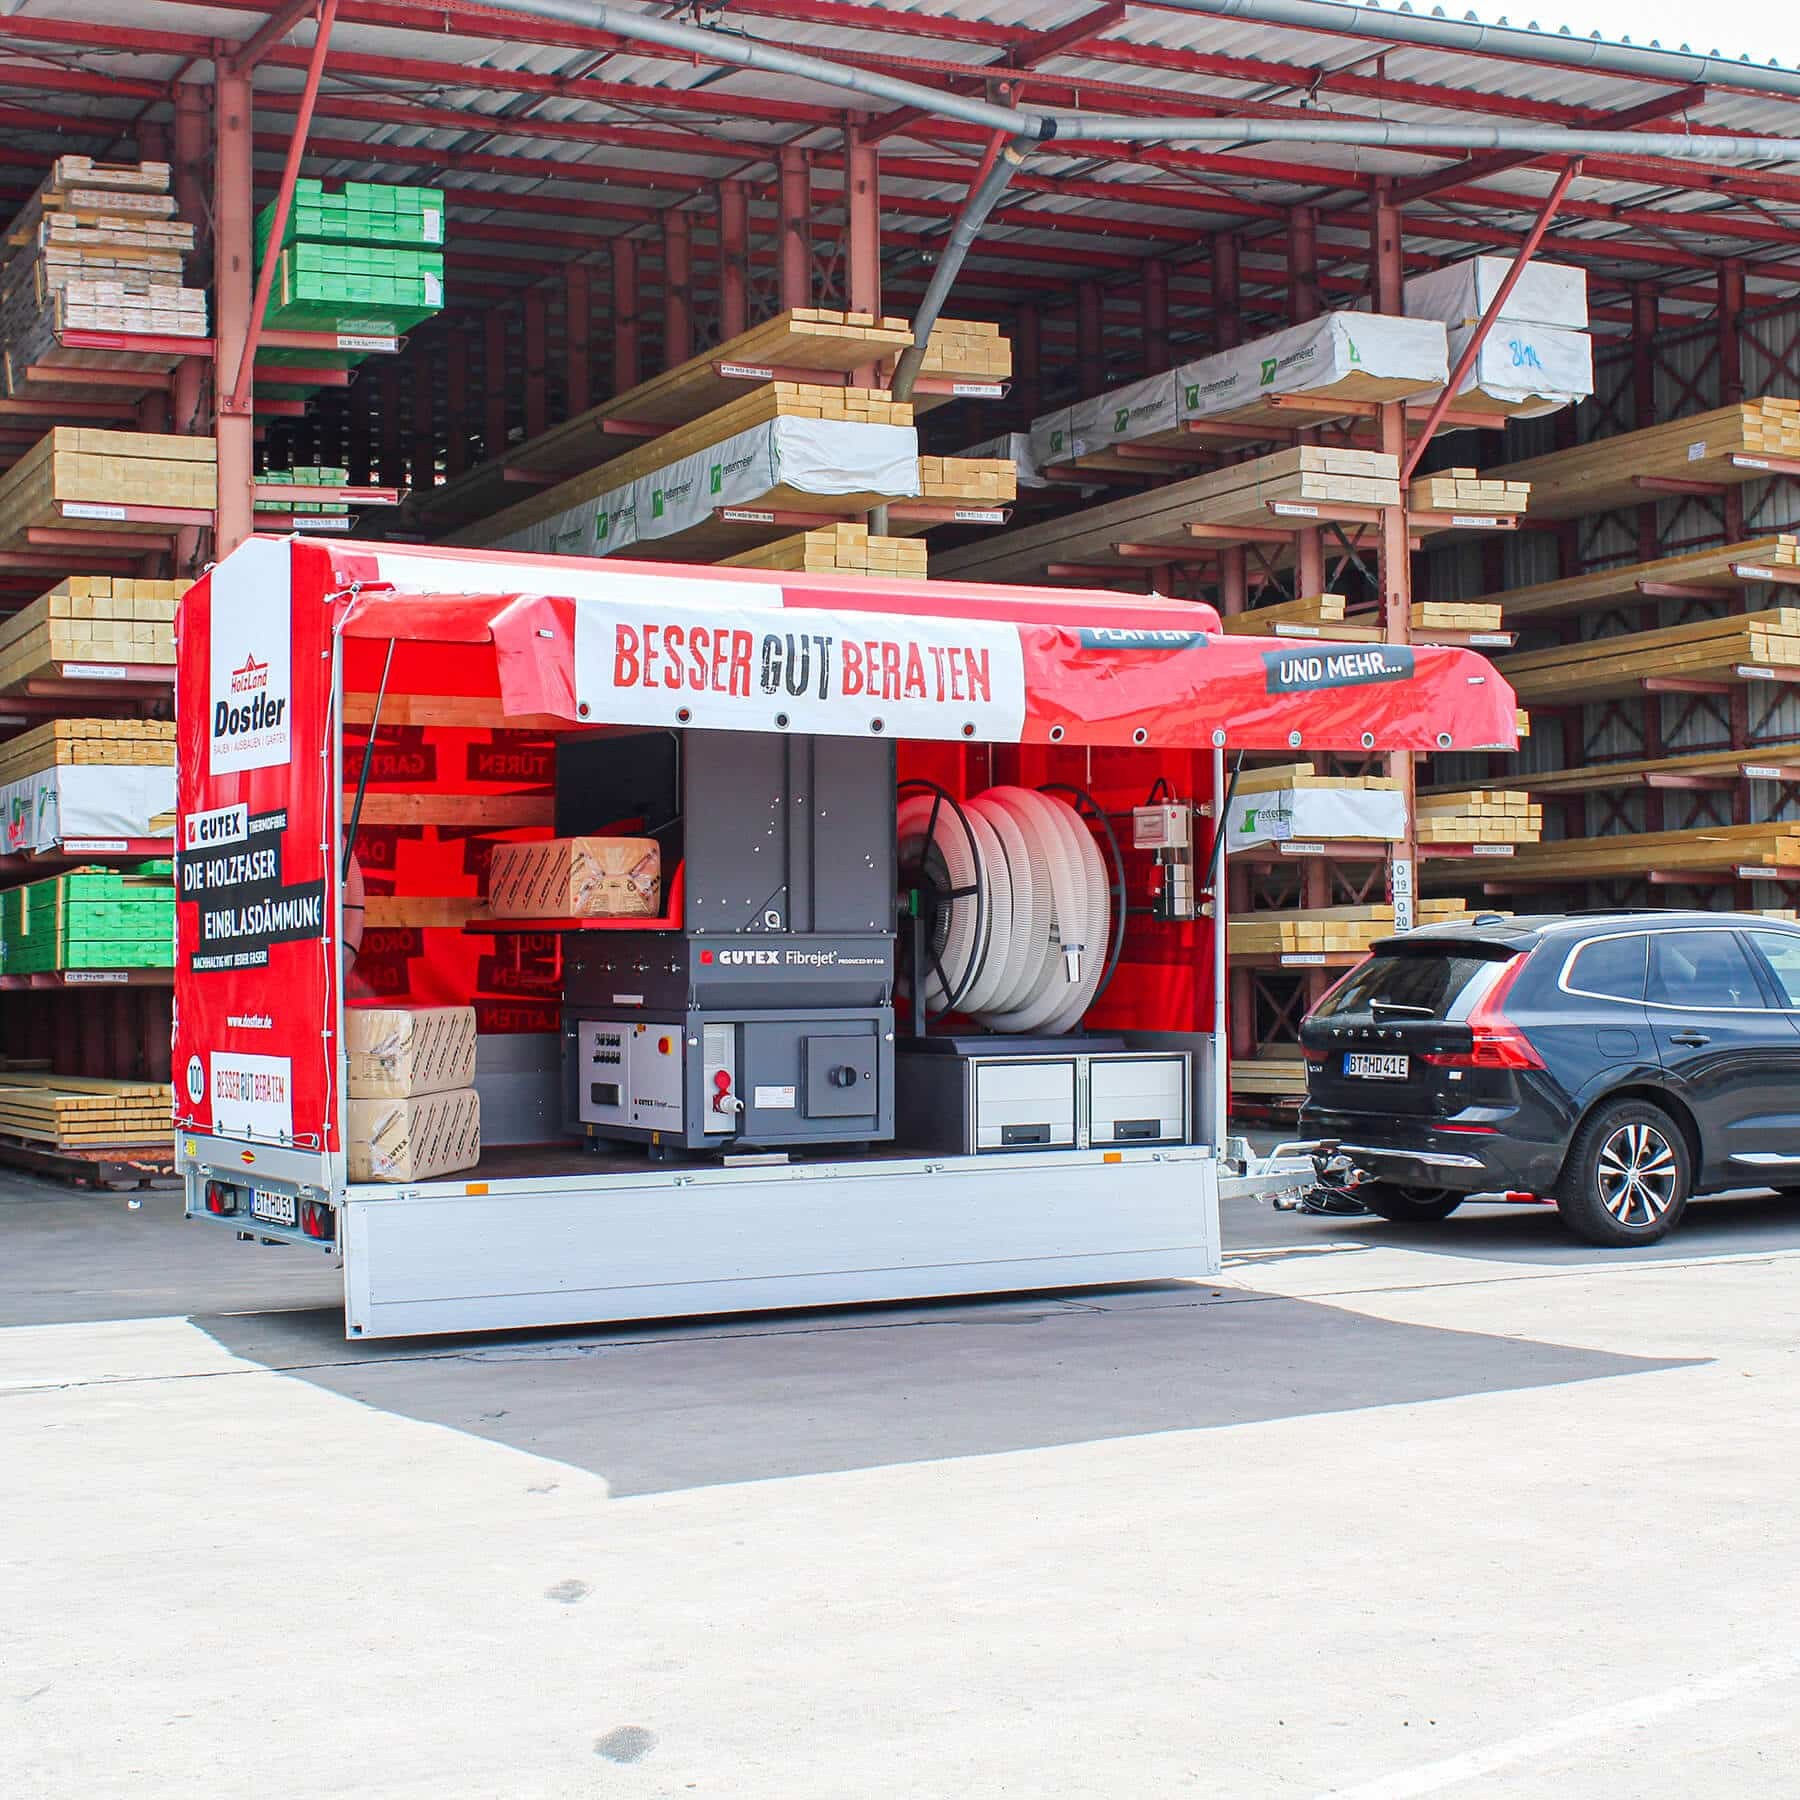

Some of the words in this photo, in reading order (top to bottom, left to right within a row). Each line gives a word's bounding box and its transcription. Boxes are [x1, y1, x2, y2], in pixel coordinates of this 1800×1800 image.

[613, 623, 753, 697] BESSER
[760, 633, 832, 700] GUT
[841, 639, 991, 702] BERATEN
[1280, 657, 1322, 684] UND
[1326, 651, 1403, 679] MEHR...
[214, 691, 286, 738] Dostler
[200, 812, 240, 841] GUTEX
[184, 862, 204, 891] DIE
[206, 849, 276, 888] HOLZFASER
[1396, 916, 1408, 927] 20
[719, 950, 780, 965] GUTEX
[1332, 1029, 1402, 1038] VOLVO
[1350, 1054, 1363, 1073] BT
[217, 1070, 240, 1101] BESSER
[255, 1073, 285, 1103] BERATEN
